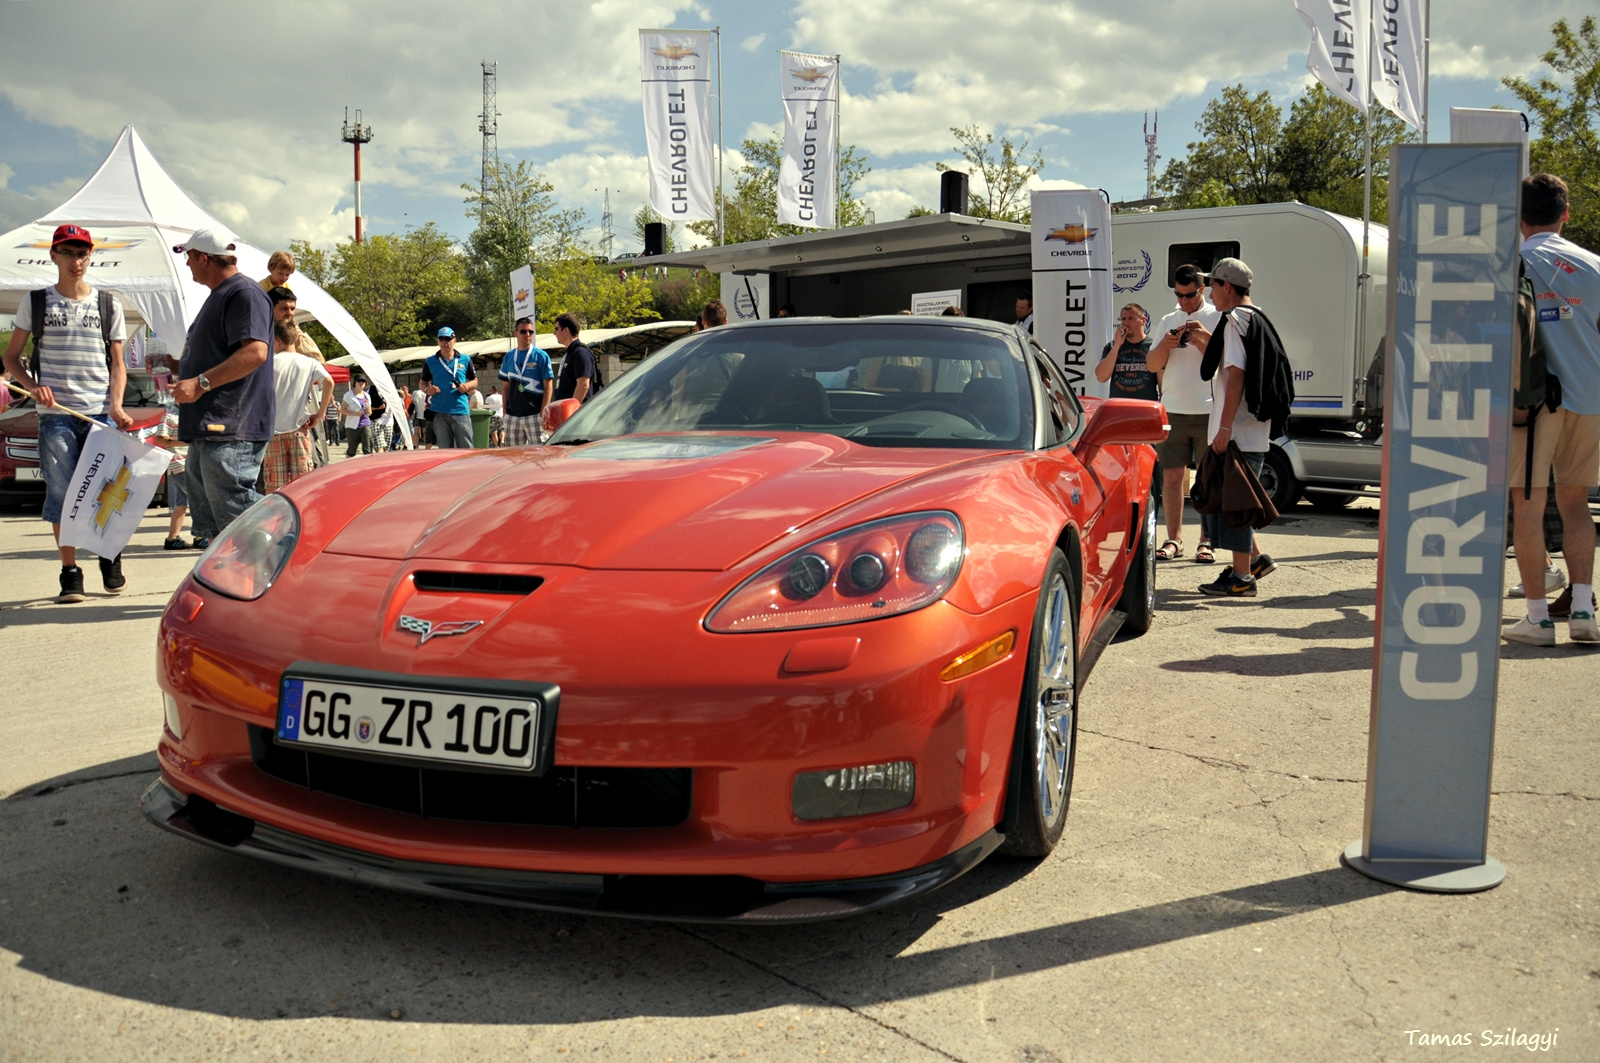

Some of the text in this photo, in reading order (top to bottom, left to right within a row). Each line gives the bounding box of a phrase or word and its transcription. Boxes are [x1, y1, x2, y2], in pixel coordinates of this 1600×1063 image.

[16, 258, 122, 268] CHELET
[1292, 370, 1314, 381] HIP
[1399, 203, 1499, 700] CORVETTE
[69, 452, 106, 522] CHEVROLET
[286, 715, 295, 729] D
[303, 689, 533, 758] GG ZR 100
